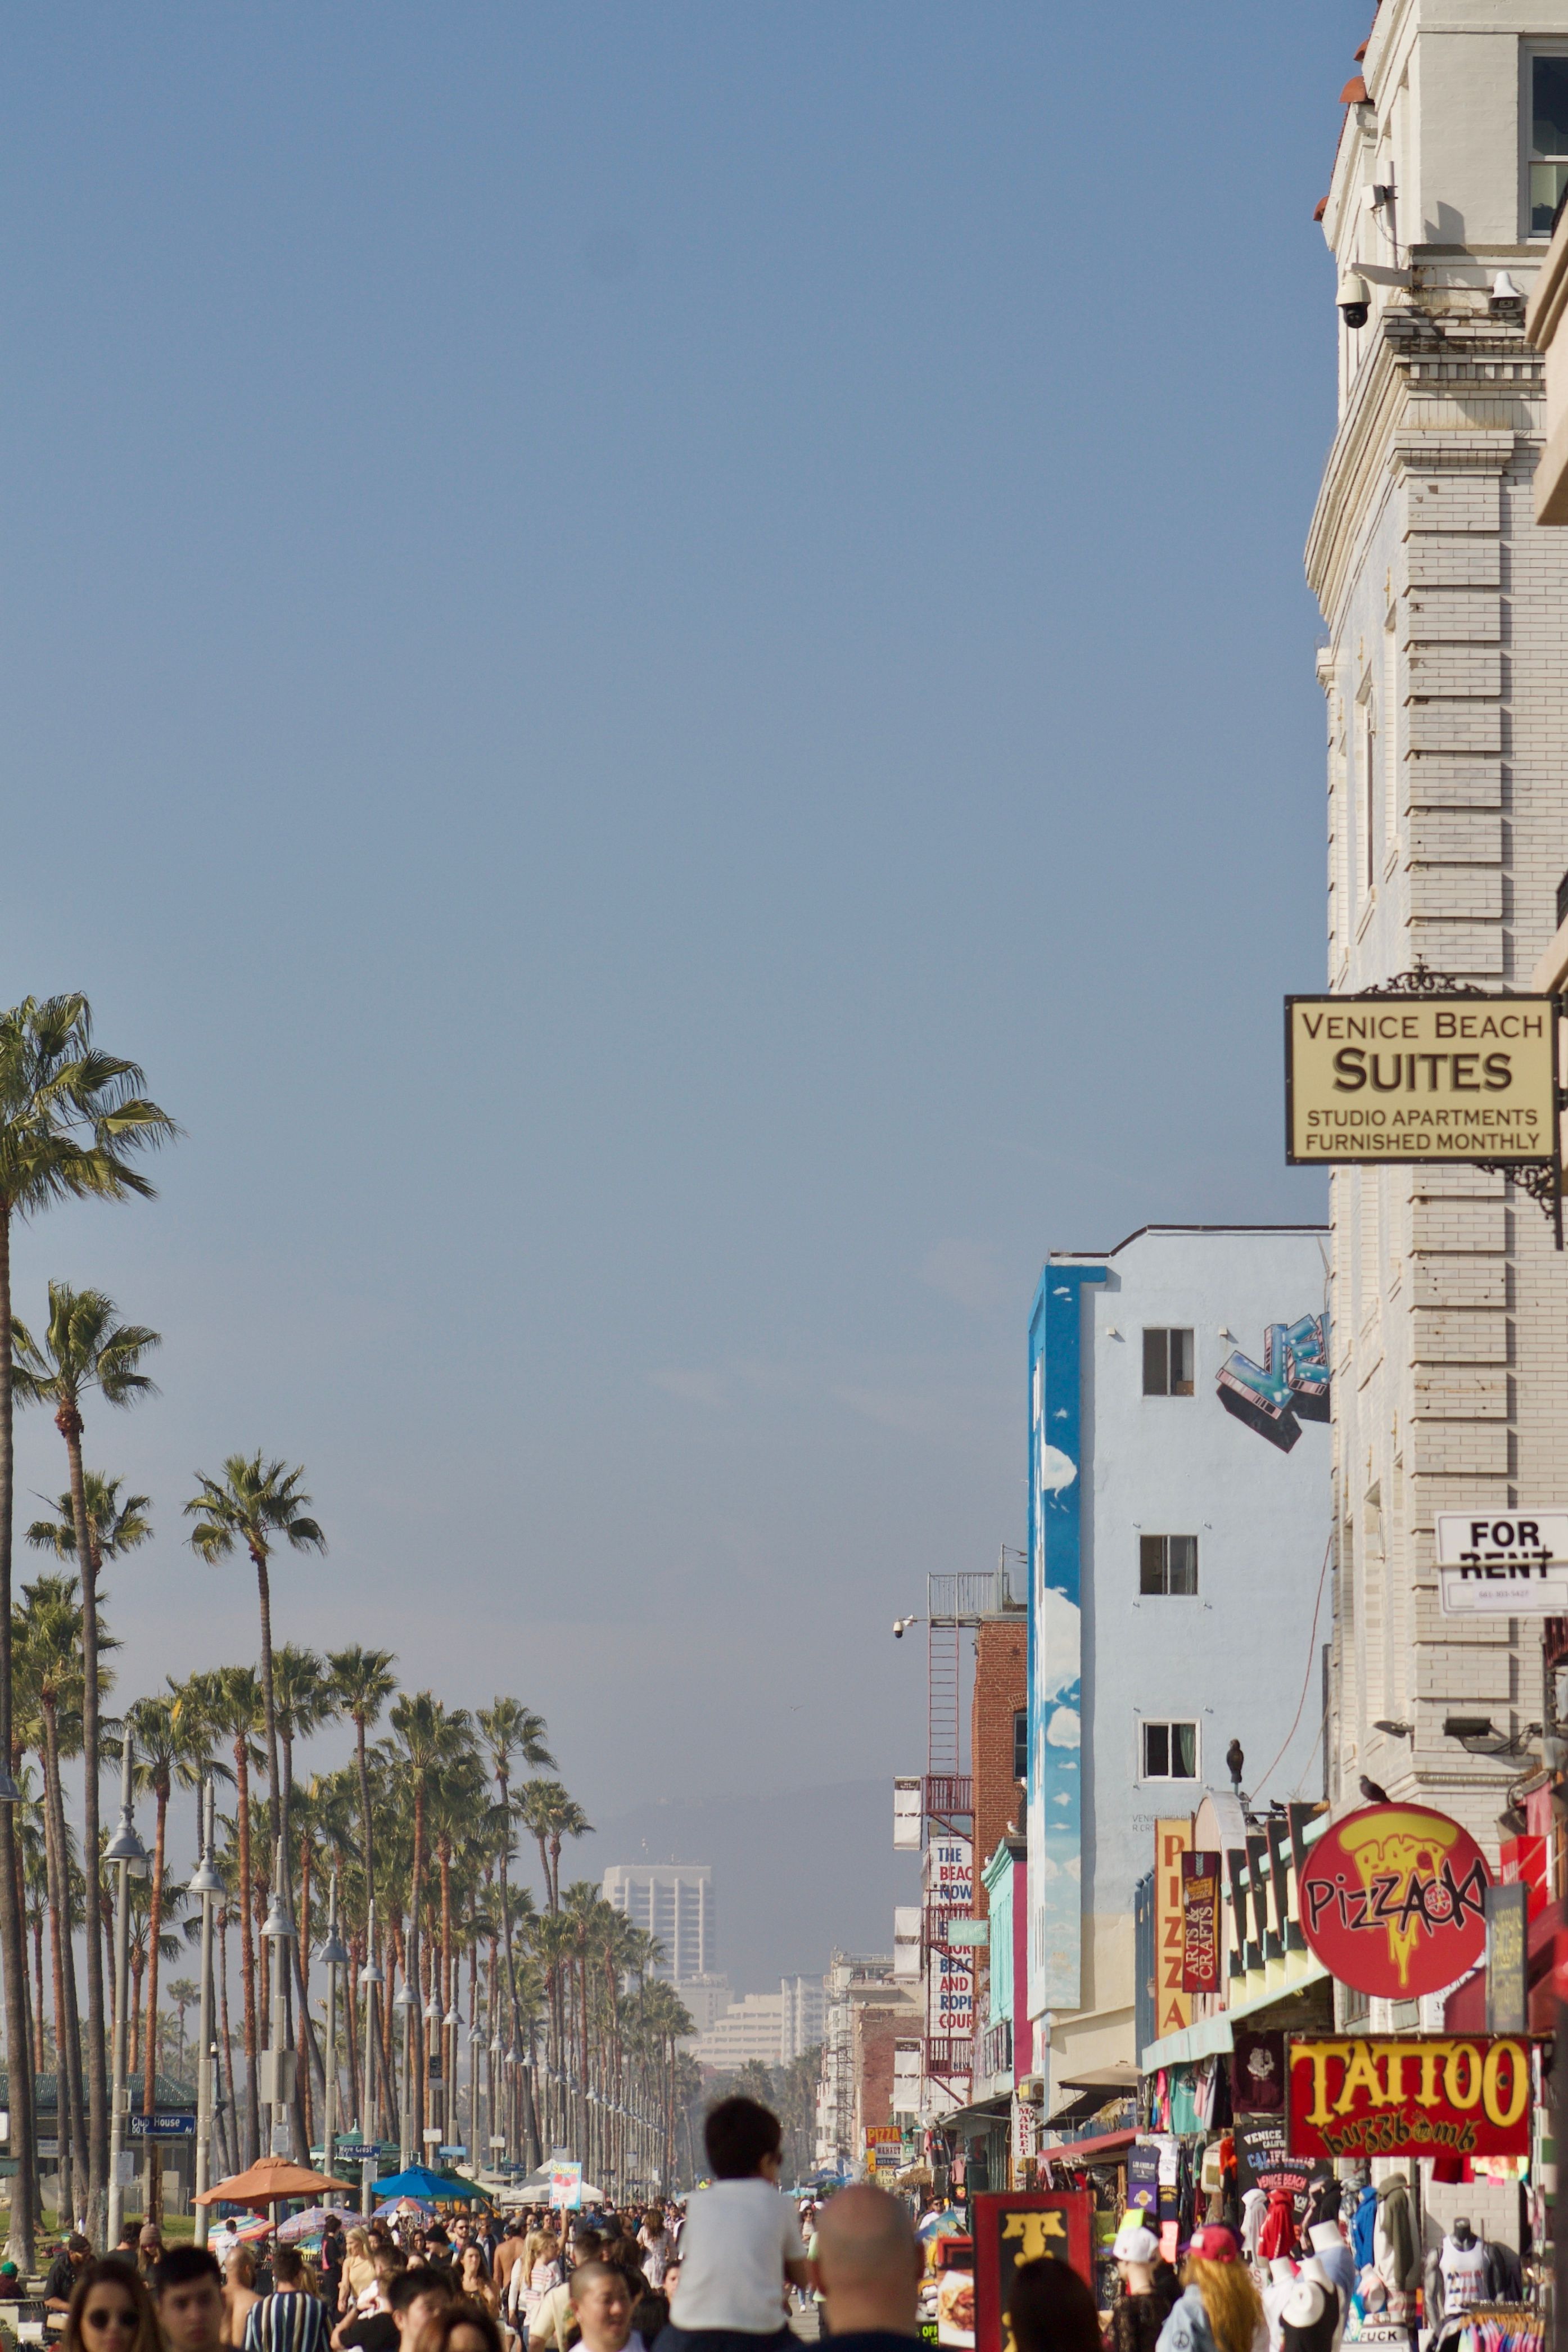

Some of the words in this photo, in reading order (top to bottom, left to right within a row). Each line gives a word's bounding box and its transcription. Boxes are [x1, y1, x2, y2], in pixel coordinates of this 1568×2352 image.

[1302, 1013, 1420, 1040] VENICE
[1434, 1012, 1543, 1039] BEACH
[1332, 1046, 1513, 1093] SUITES
[1307, 1109, 1386, 1127] STUDIO
[1391, 1109, 1538, 1126] APARTMENTS
[1305, 1134, 1431, 1152] FURNISHED
[1436, 1132, 1540, 1150] MONTHLY
[1470, 1520, 1540, 1547] FOR
[1459, 1551, 1553, 1579] RENT
[937, 1848, 962, 1862] THE
[939, 1866, 973, 1881] BEAC
[939, 1884, 973, 1899] NOW
[1185, 1907, 1200, 1922] &
[1163, 1834, 1186, 2029] PIZZA
[1185, 1927, 1199, 1976] ARTS
[1199, 1906, 1214, 1980] CRAFTS
[940, 1958, 973, 1973] BEAC
[940, 1976, 969, 1992] AND
[939, 2013, 973, 2029] COUR
[1290, 2039, 1529, 2127] TATTOO
[132, 2117, 150, 2127] Club
[153, 2117, 180, 2127] House
[1018, 2107, 1029, 2155] MARKET
[867, 2127, 900, 2143] PIZZA
[1243, 2129, 1282, 2145] VENICE
[1262, 2139, 1287, 2149] CALIFO
[1257, 2173, 1282, 2189] VENICE
[1283, 2173, 1307, 2191] BEACH
